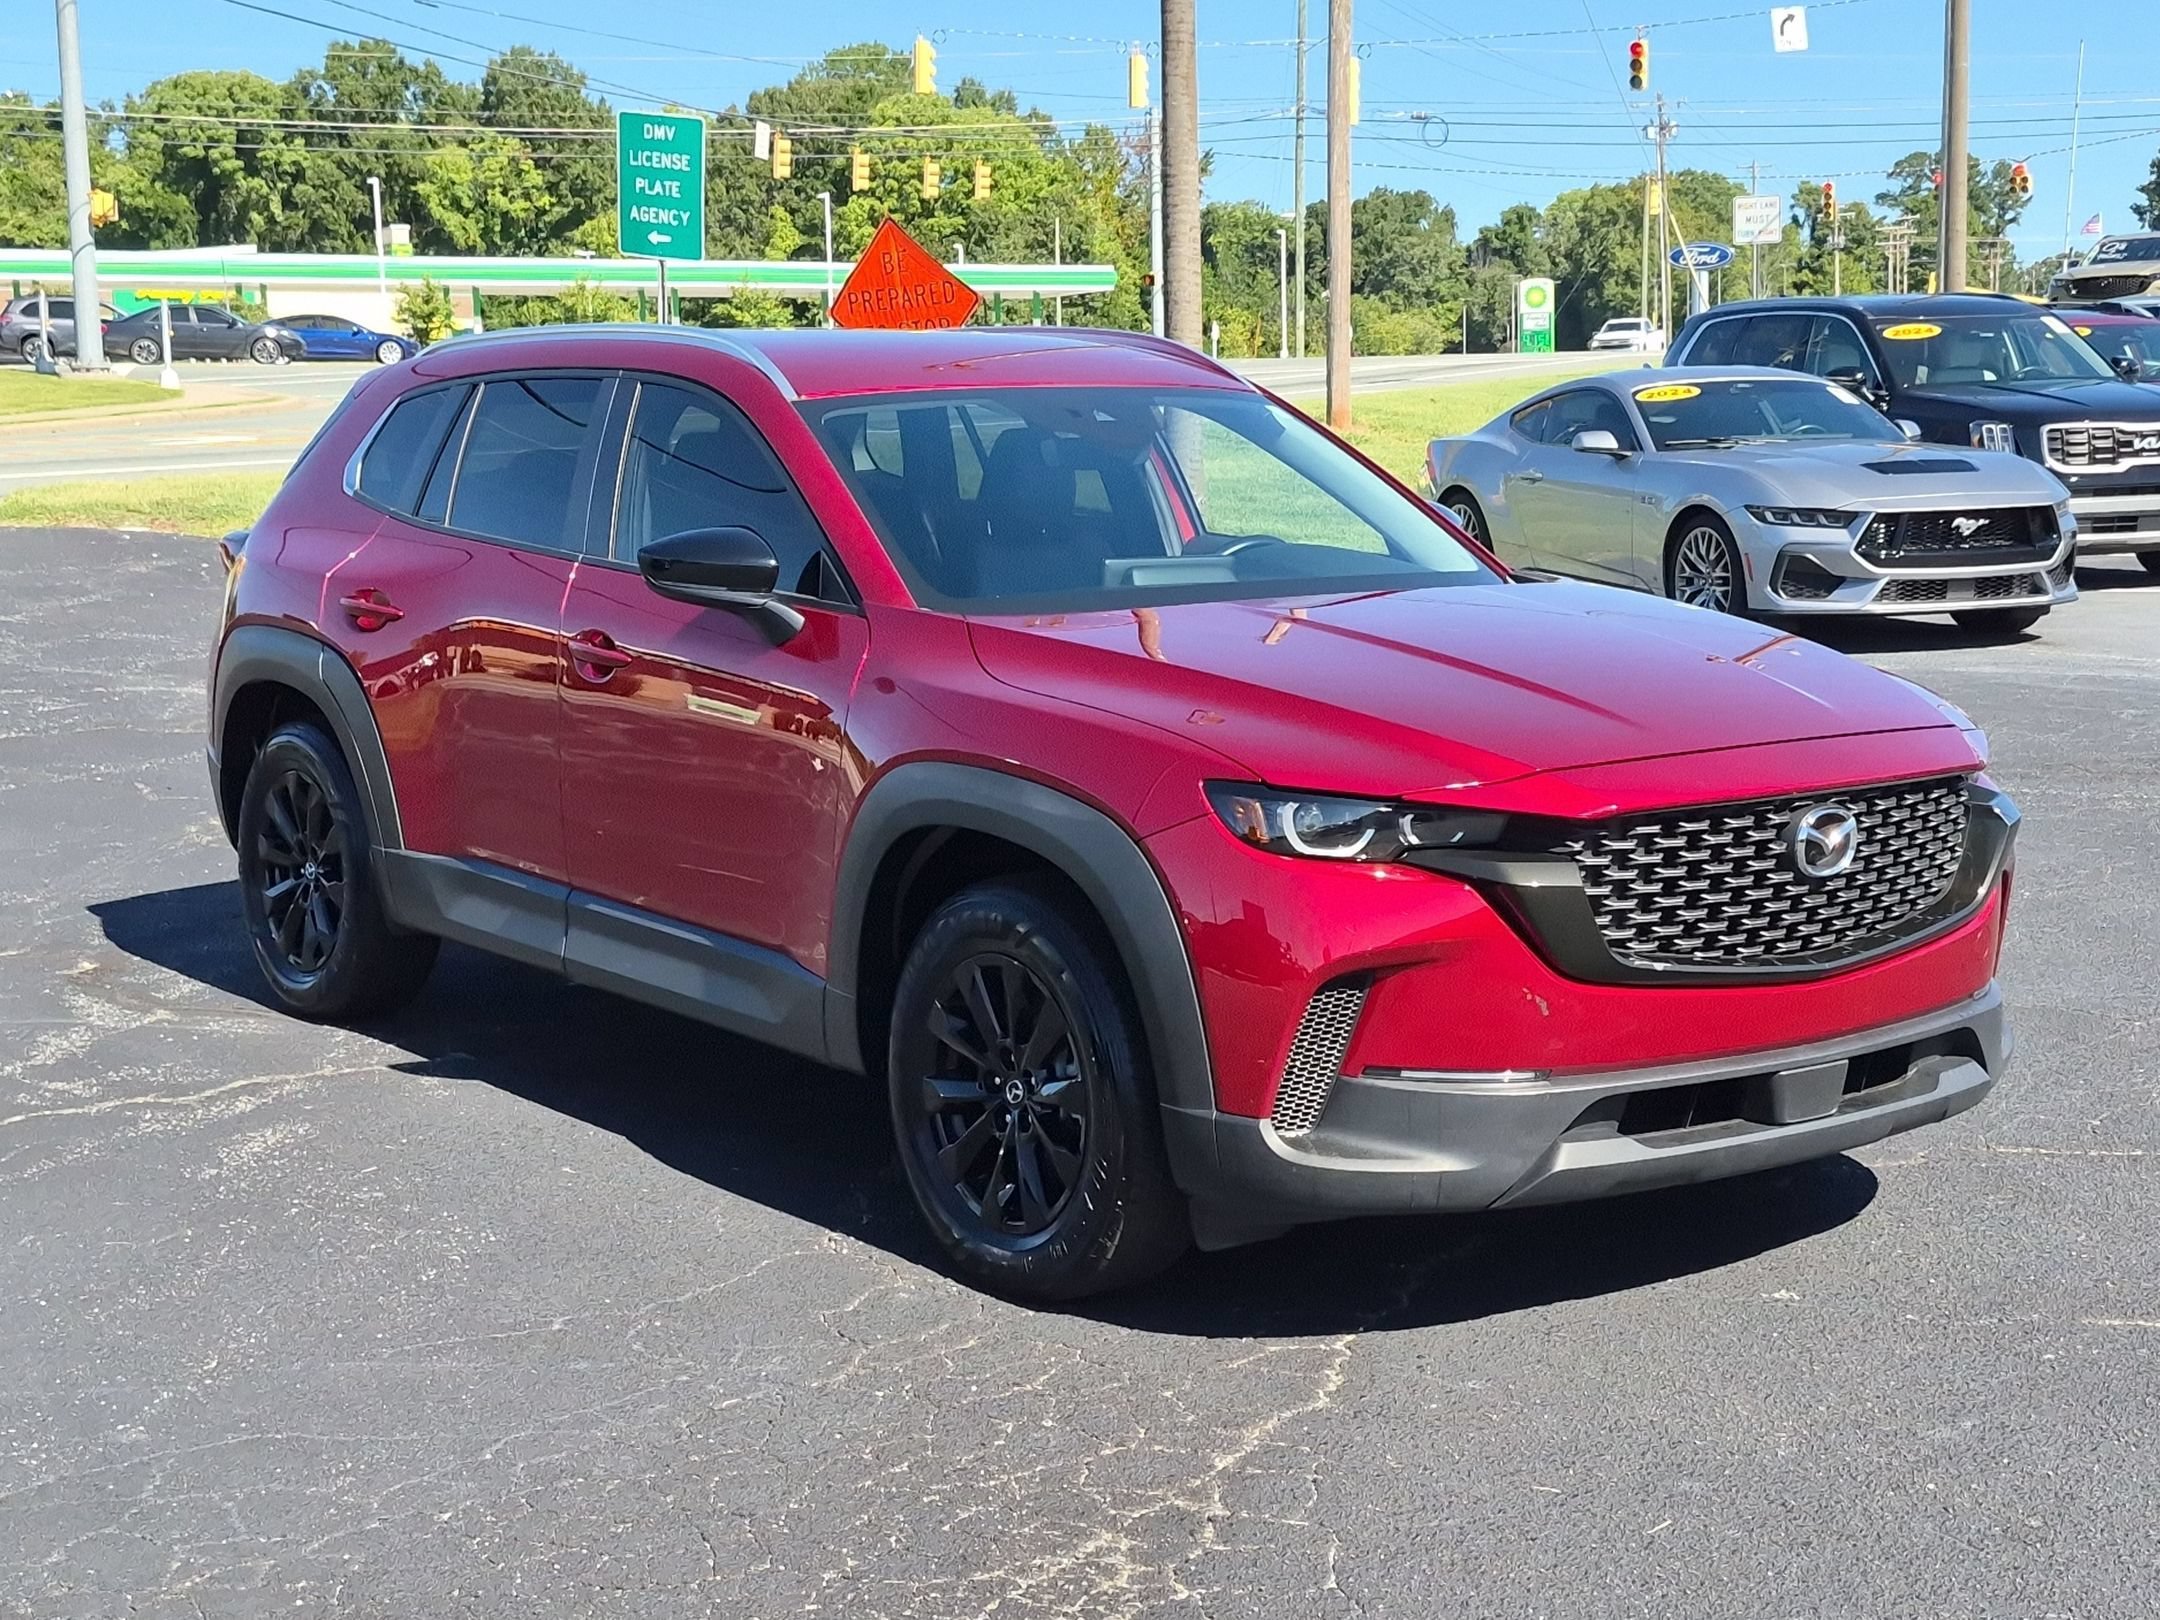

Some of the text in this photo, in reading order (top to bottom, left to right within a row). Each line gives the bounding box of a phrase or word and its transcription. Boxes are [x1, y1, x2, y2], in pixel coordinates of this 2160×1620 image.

[643, 123, 676, 141] DMV
[629, 149, 691, 171] LICENSE
[635, 177, 681, 198] PLATE
[629, 204, 691, 227] AGENCY
[1745, 214, 1770, 224] MUST
[882, 249, 908, 275] BE
[1679, 247, 1720, 265] Ford
[848, 280, 955, 315] PREPARED
[1892, 327, 1934, 337] 2024
[1645, 387, 1693, 399] 2024
